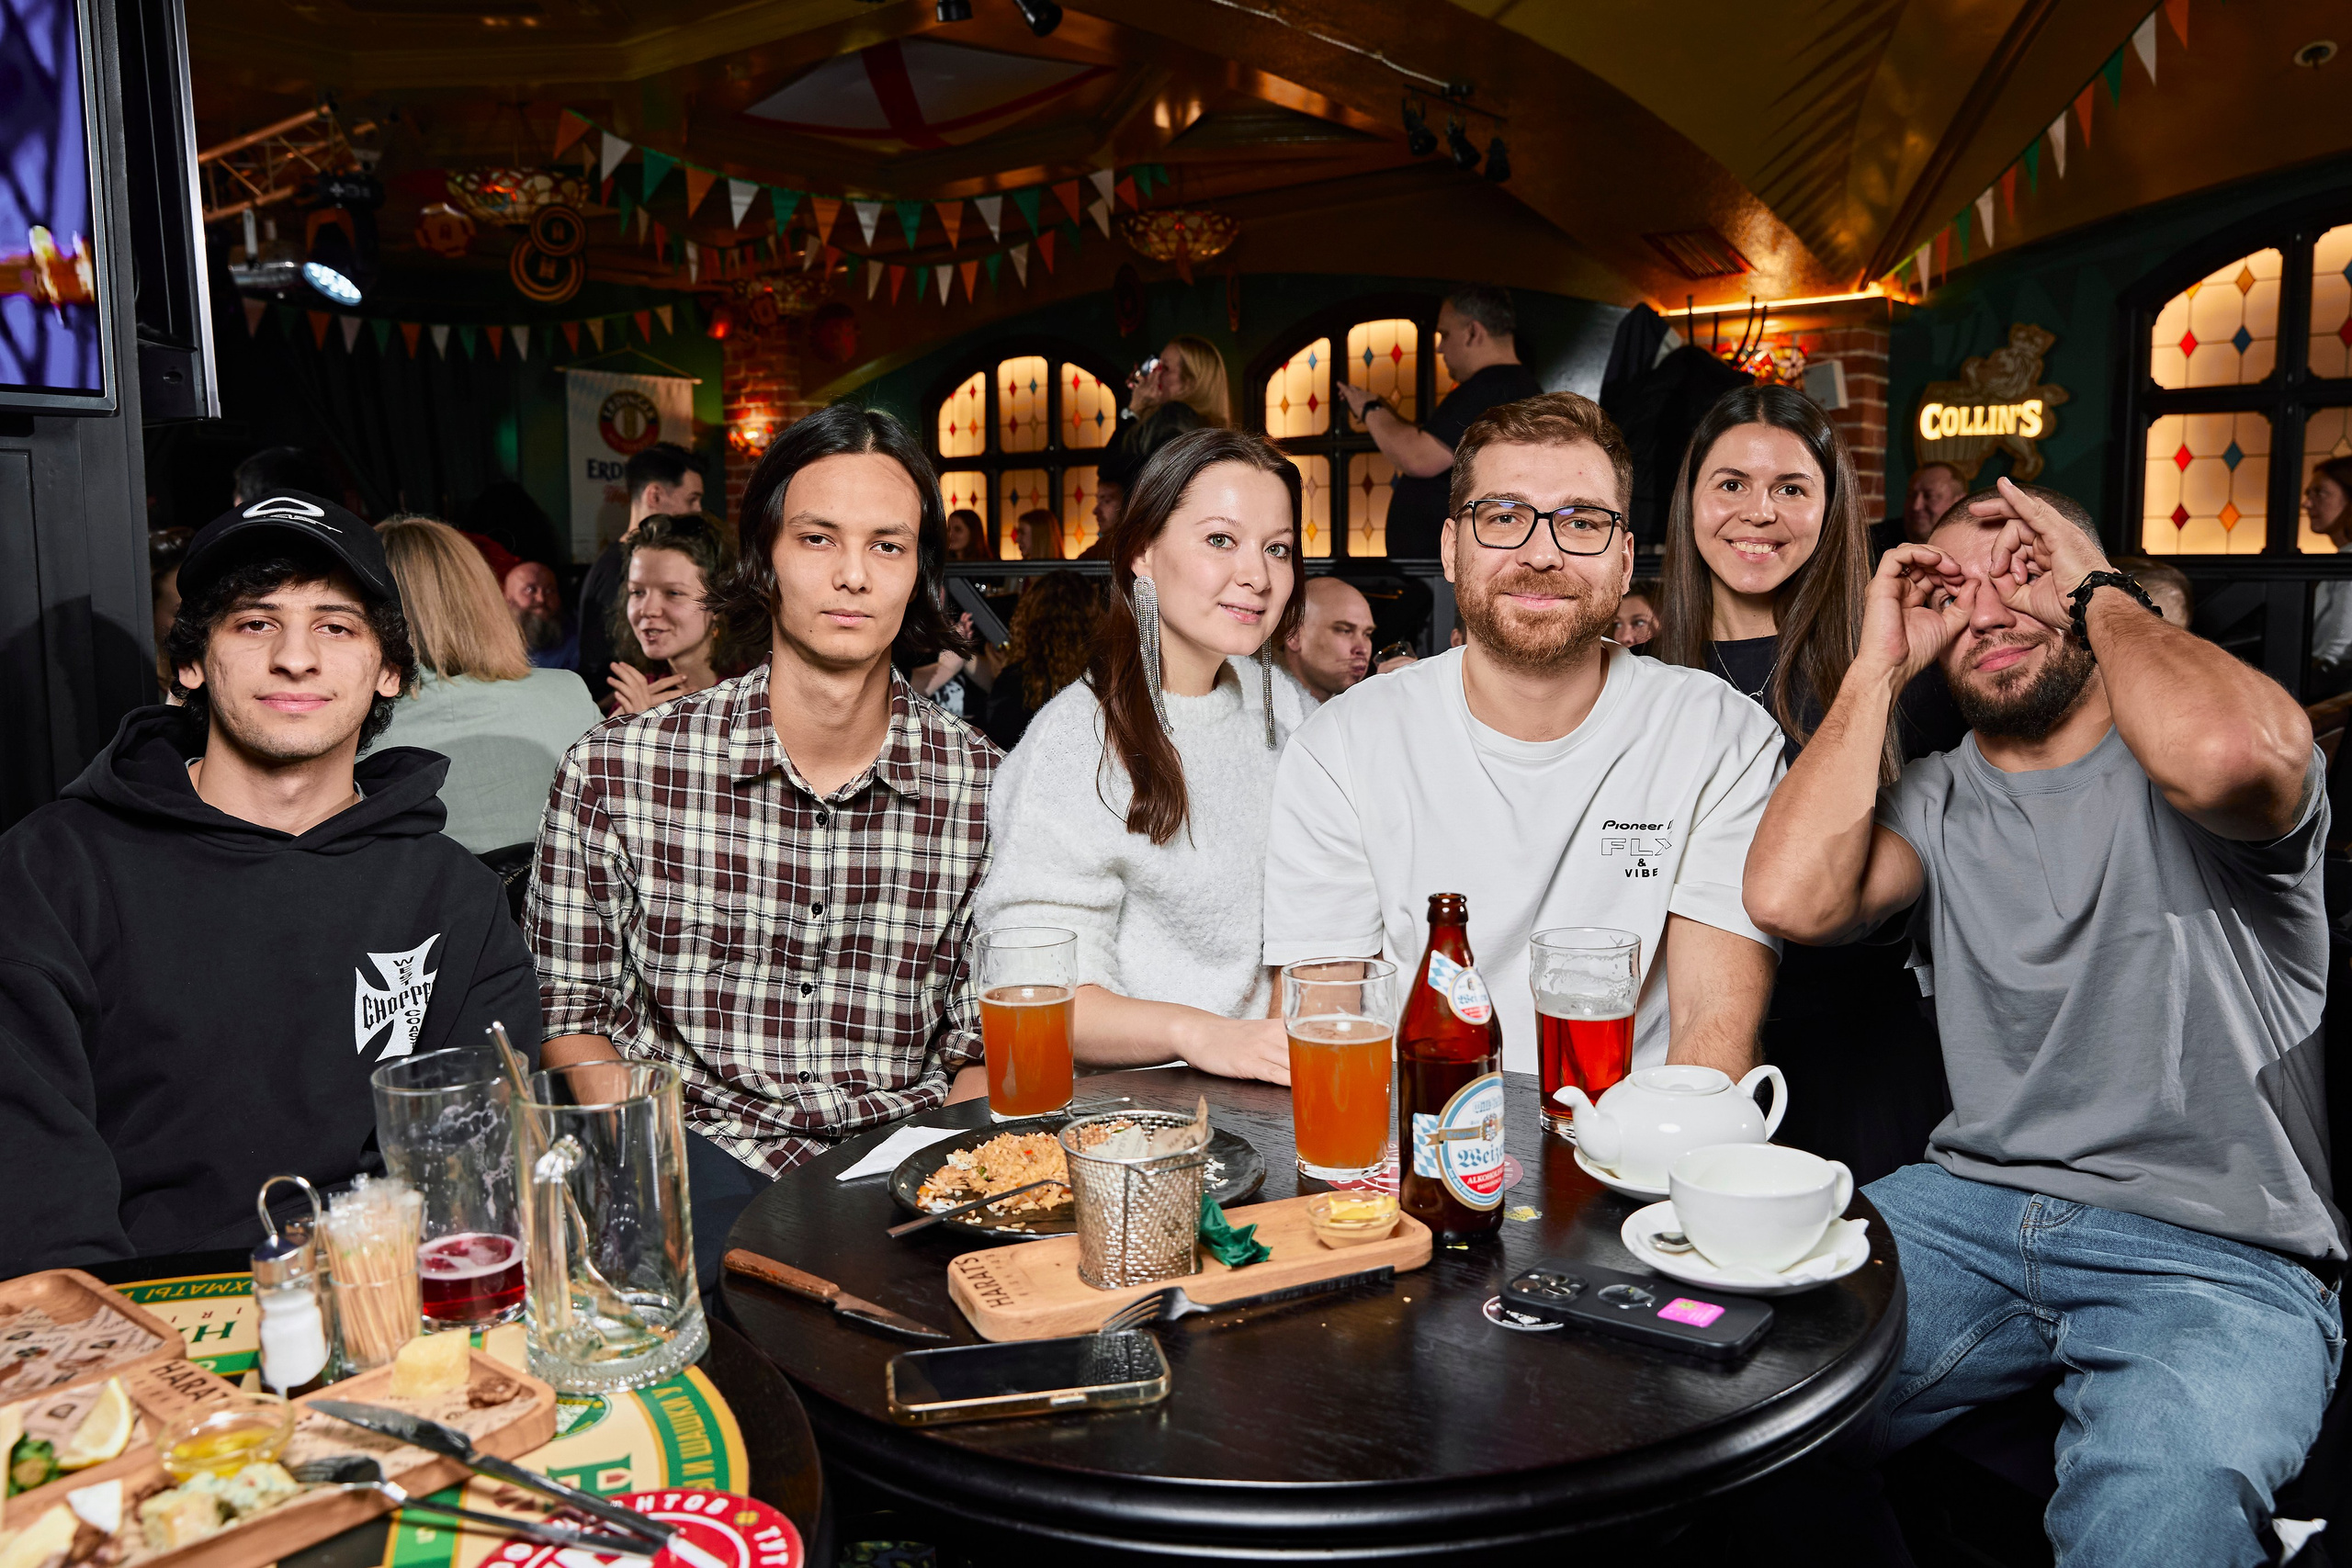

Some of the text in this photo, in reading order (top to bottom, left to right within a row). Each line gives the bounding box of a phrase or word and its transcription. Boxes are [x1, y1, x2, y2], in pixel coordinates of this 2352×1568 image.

[1920, 400, 2042, 440] COLLIN'S
[1601, 819, 1664, 830] Pioneer
[1637, 858, 1646, 867] &
[392, 955, 414, 987] WEST
[144, 1280, 253, 1301] ХМАТЫ
